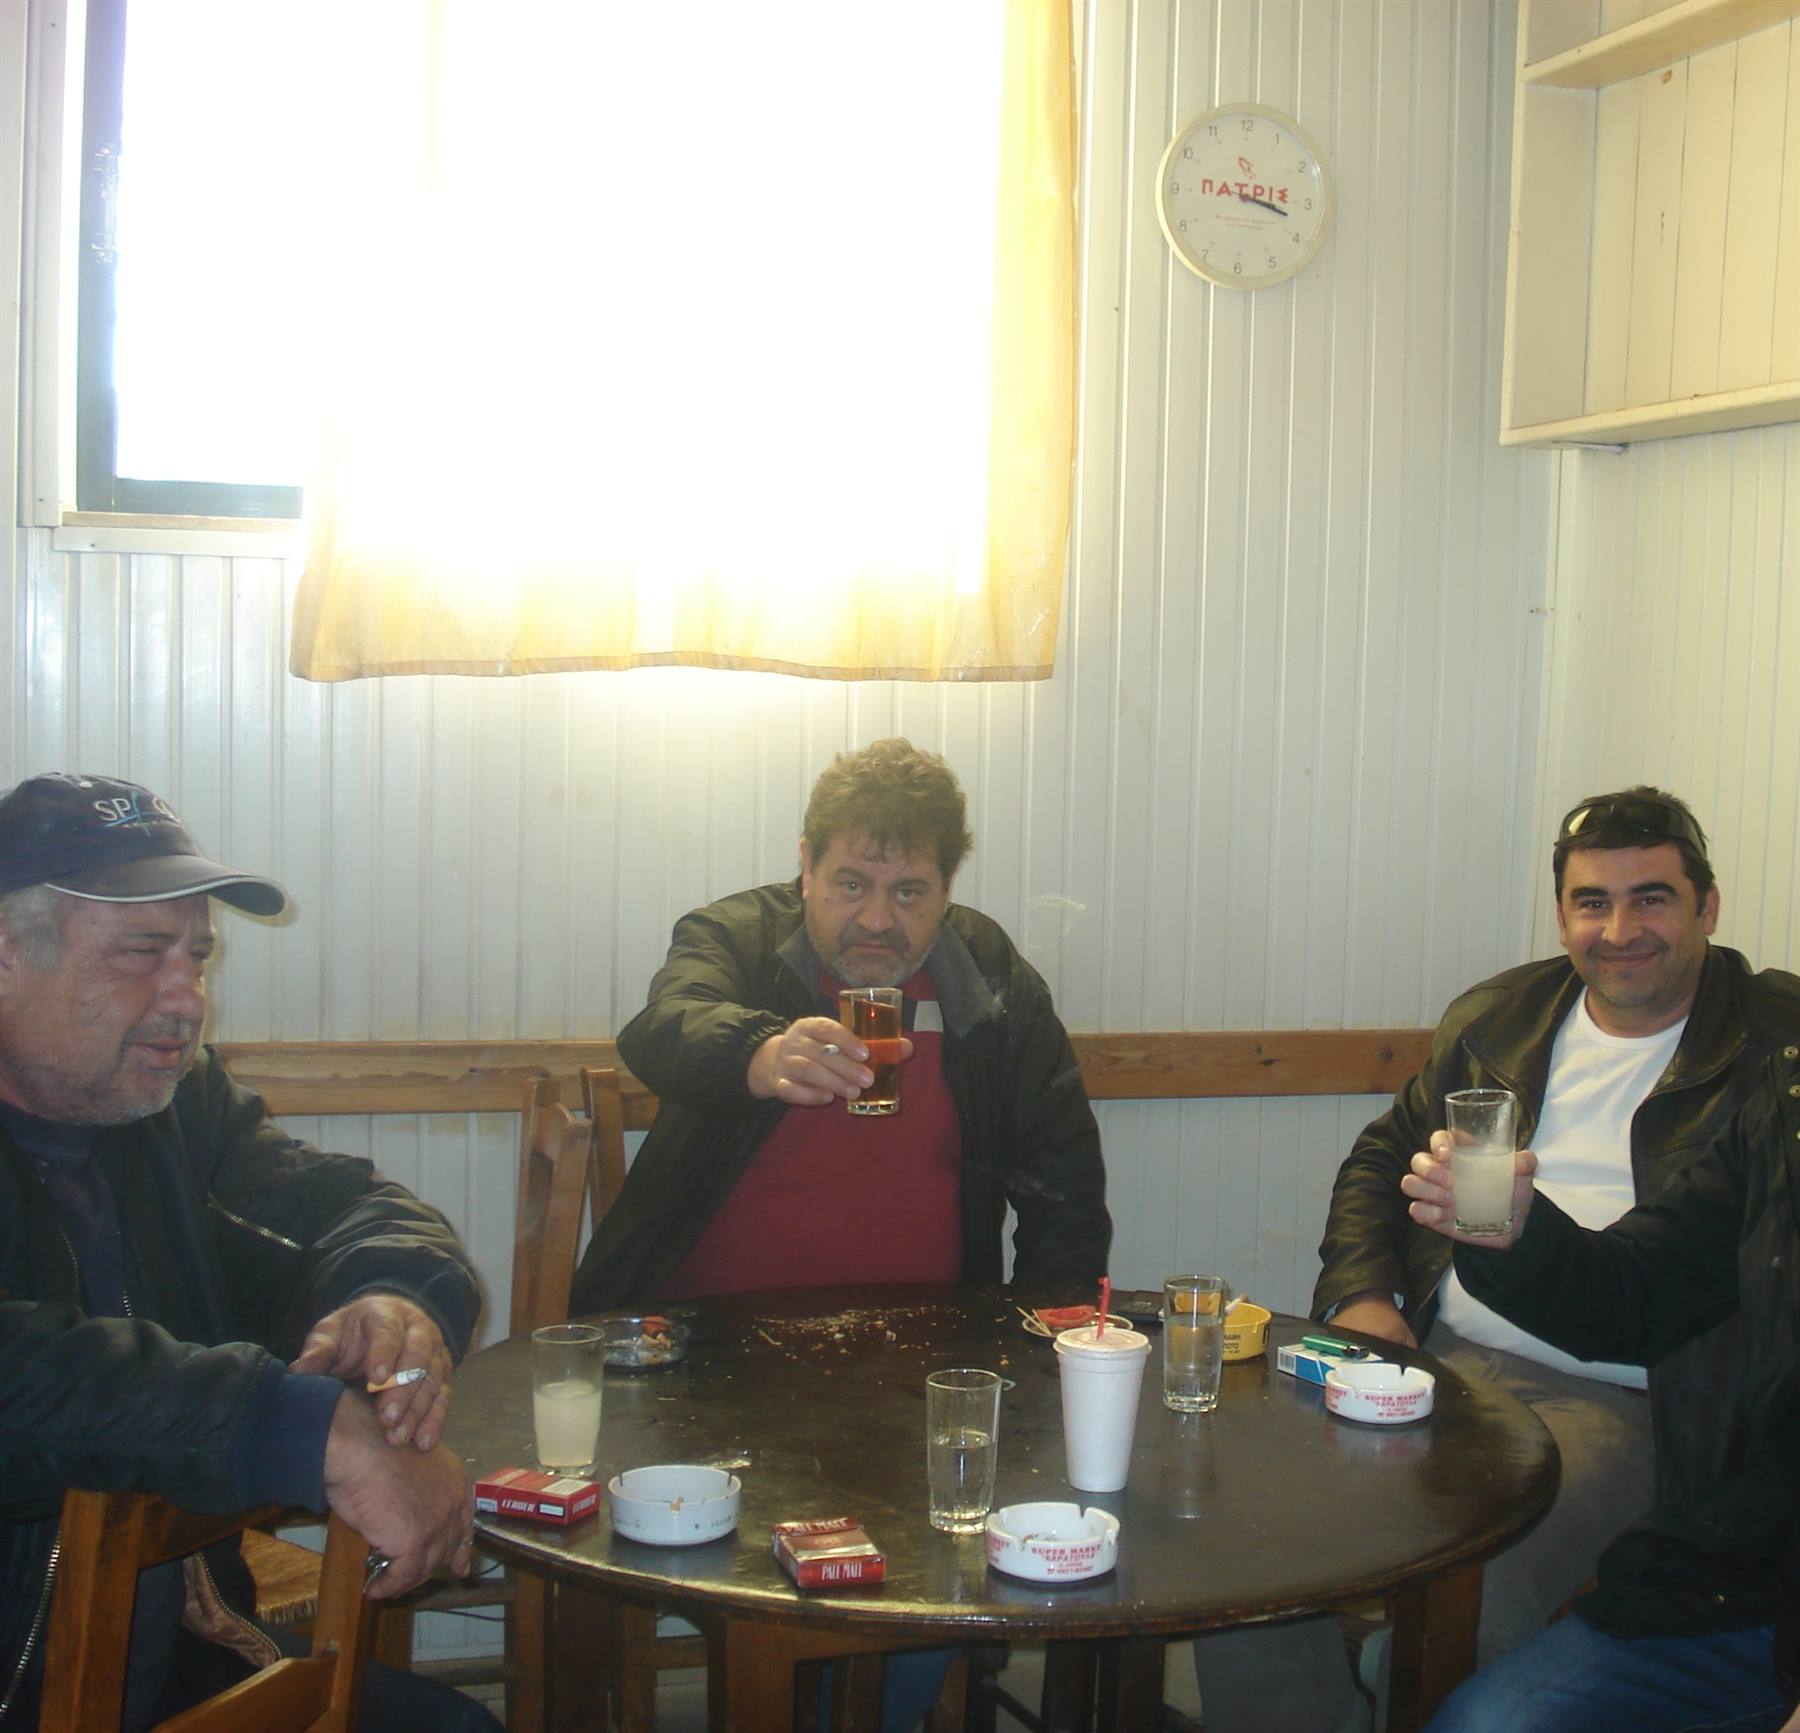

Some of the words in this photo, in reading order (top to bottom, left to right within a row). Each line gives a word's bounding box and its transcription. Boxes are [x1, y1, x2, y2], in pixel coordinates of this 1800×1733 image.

[1208, 125, 1218, 137] 11
[1241, 119, 1254, 132] 12
[1183, 147, 1194, 160] 10
[1298, 161, 1306, 174] 2
[1171, 182, 1180, 195] 9
[1201, 178, 1289, 204] ΠΑΤΡΙΣ
[1304, 198, 1312, 211] 3
[1179, 219, 1188, 233] 8
[1292, 232, 1300, 243] 4
[1202, 249, 1209, 261] 7
[1233, 261, 1243, 275] 6
[1268, 256, 1277, 269] 5
[1031, 1547, 1066, 1556] SUPER
